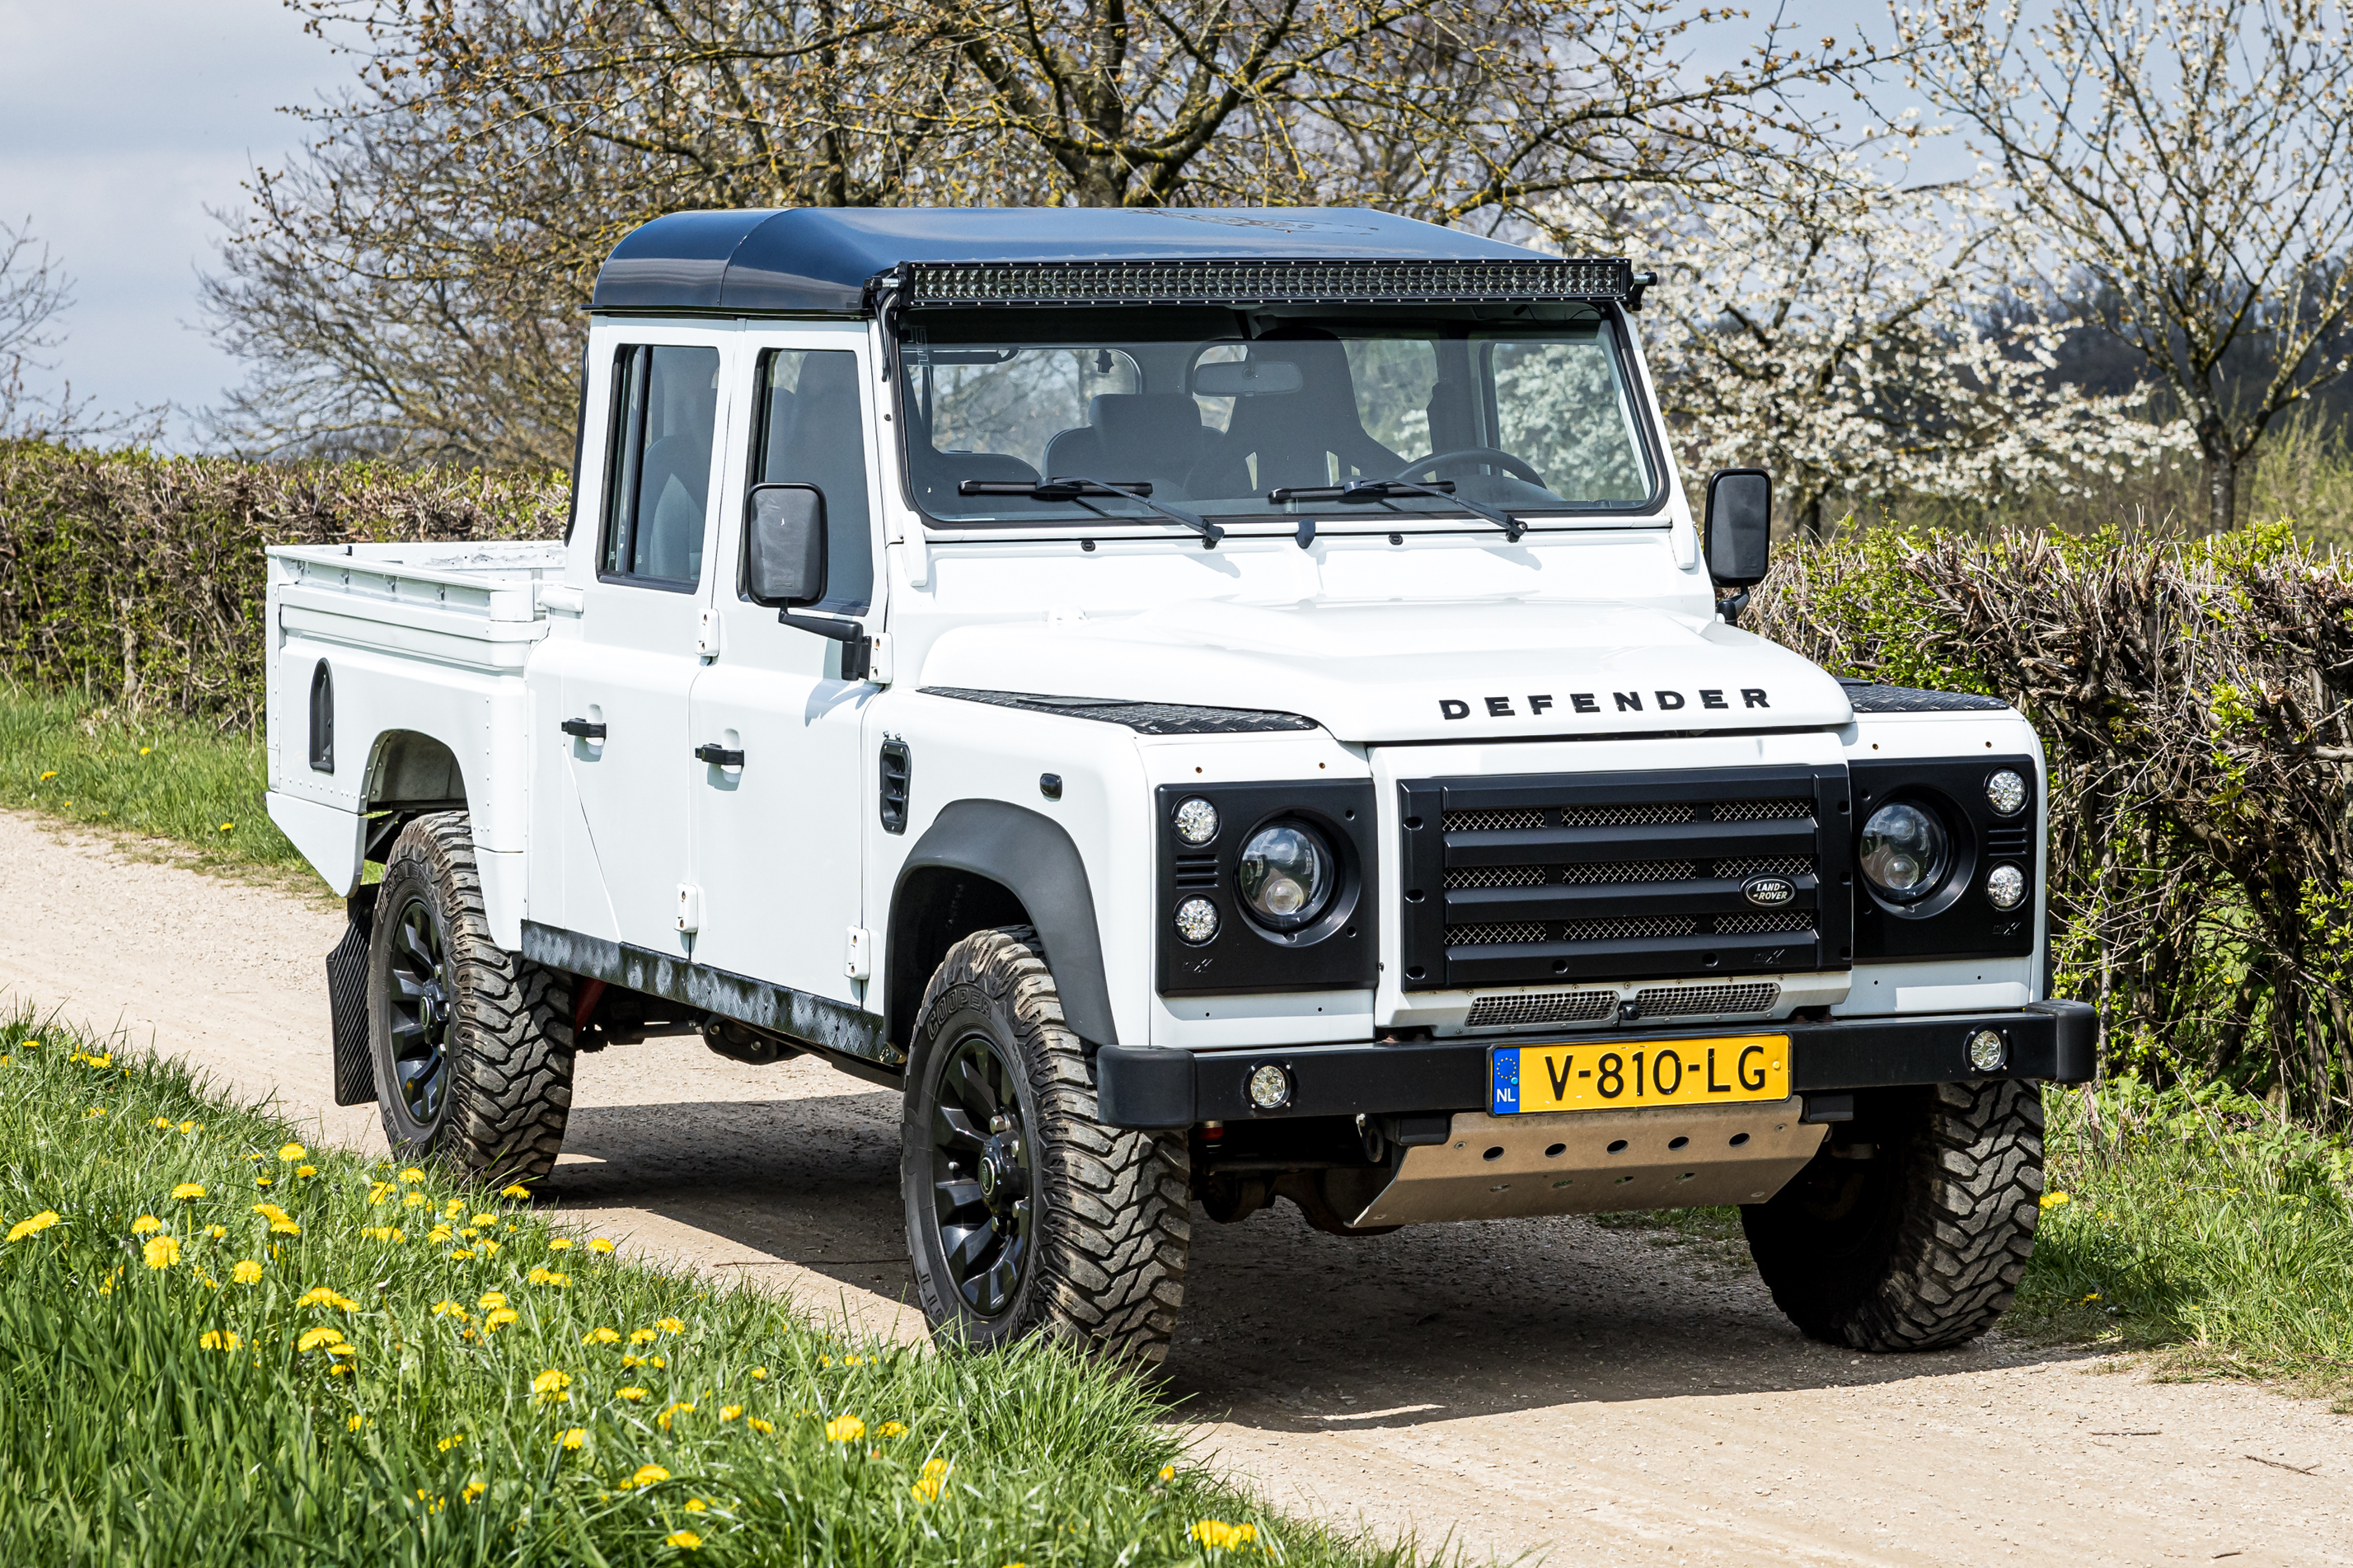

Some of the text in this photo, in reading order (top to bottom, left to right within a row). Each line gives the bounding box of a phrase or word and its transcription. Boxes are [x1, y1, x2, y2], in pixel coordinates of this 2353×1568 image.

[1438, 688, 1771, 720] DEFENDER
[1755, 882, 1780, 892] LAND
[1757, 891, 1788, 901] ROVER
[926, 988, 991, 1041] COOPER
[1544, 1045, 1766, 1102] V-810-LG
[1496, 1088, 1516, 1103] NL
